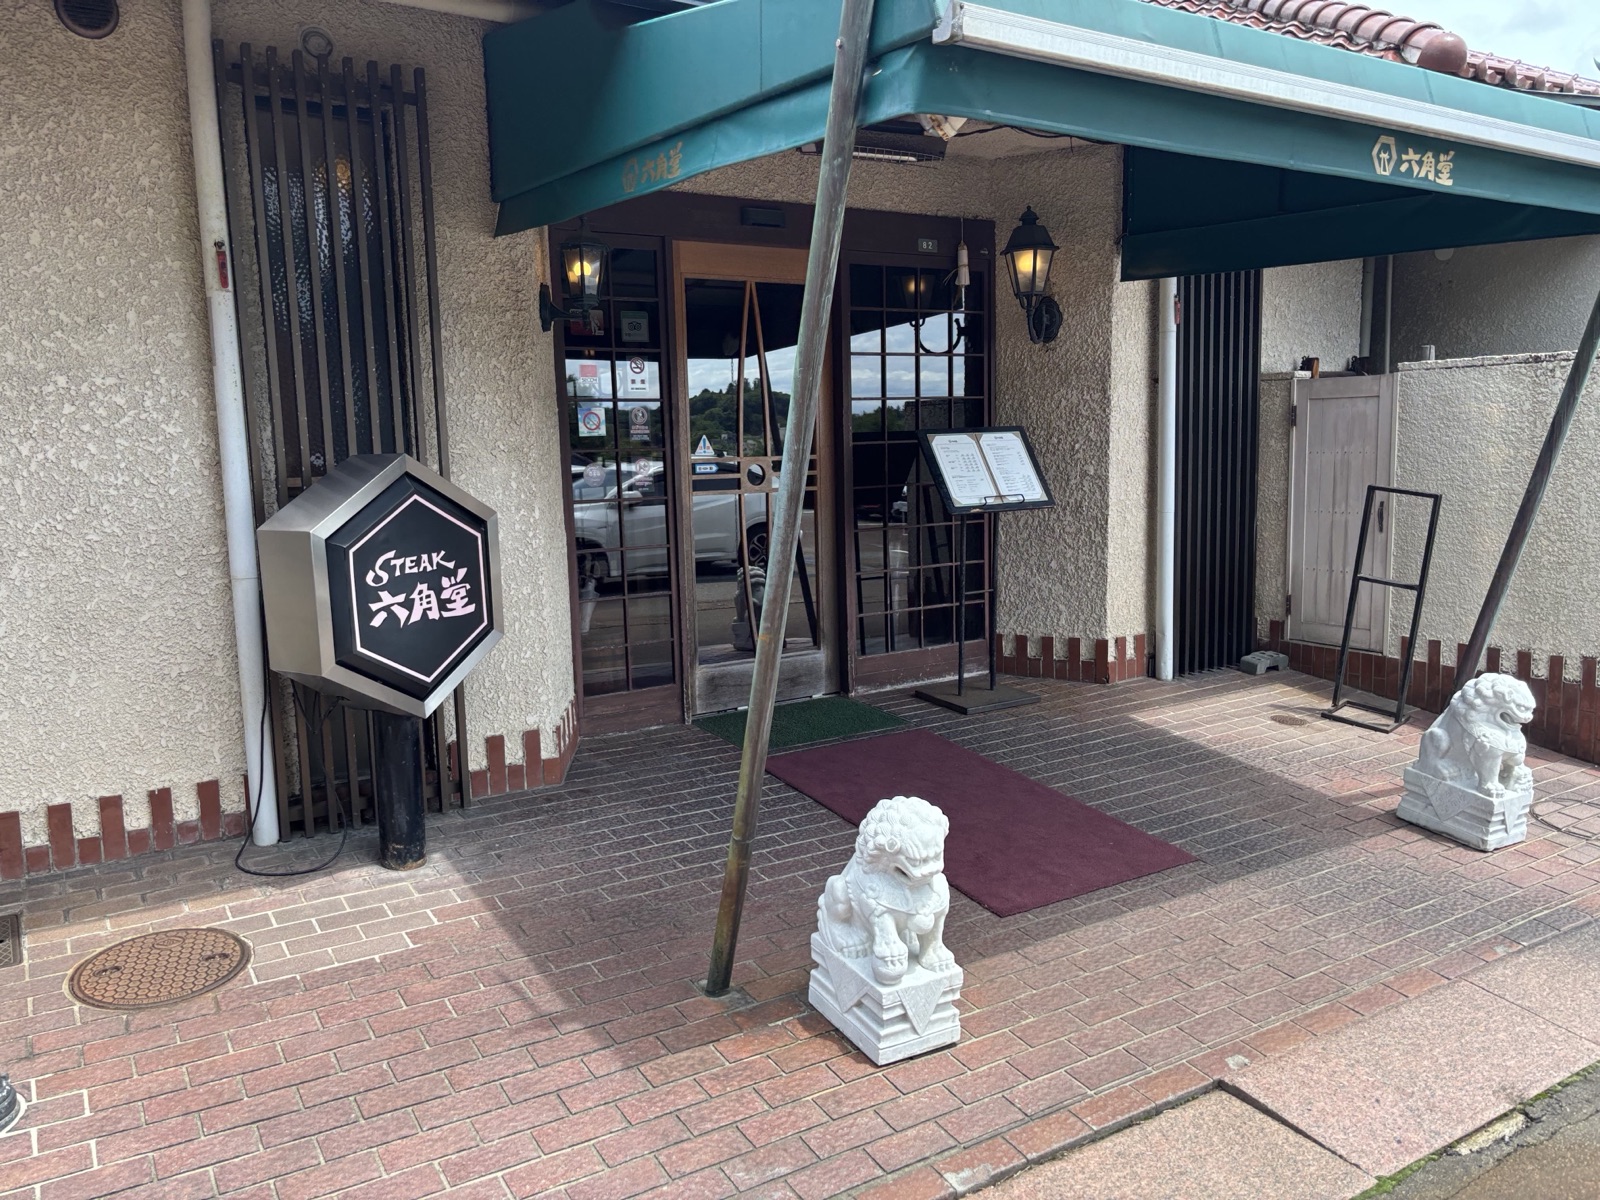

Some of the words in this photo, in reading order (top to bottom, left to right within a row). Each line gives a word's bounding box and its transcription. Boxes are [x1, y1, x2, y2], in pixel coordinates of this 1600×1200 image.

[1399, 147, 1455, 186] 六角堂
[922, 241, 933, 250] 82
[365, 550, 456, 587] STEAK
[368, 567, 476, 628] 六角堂
